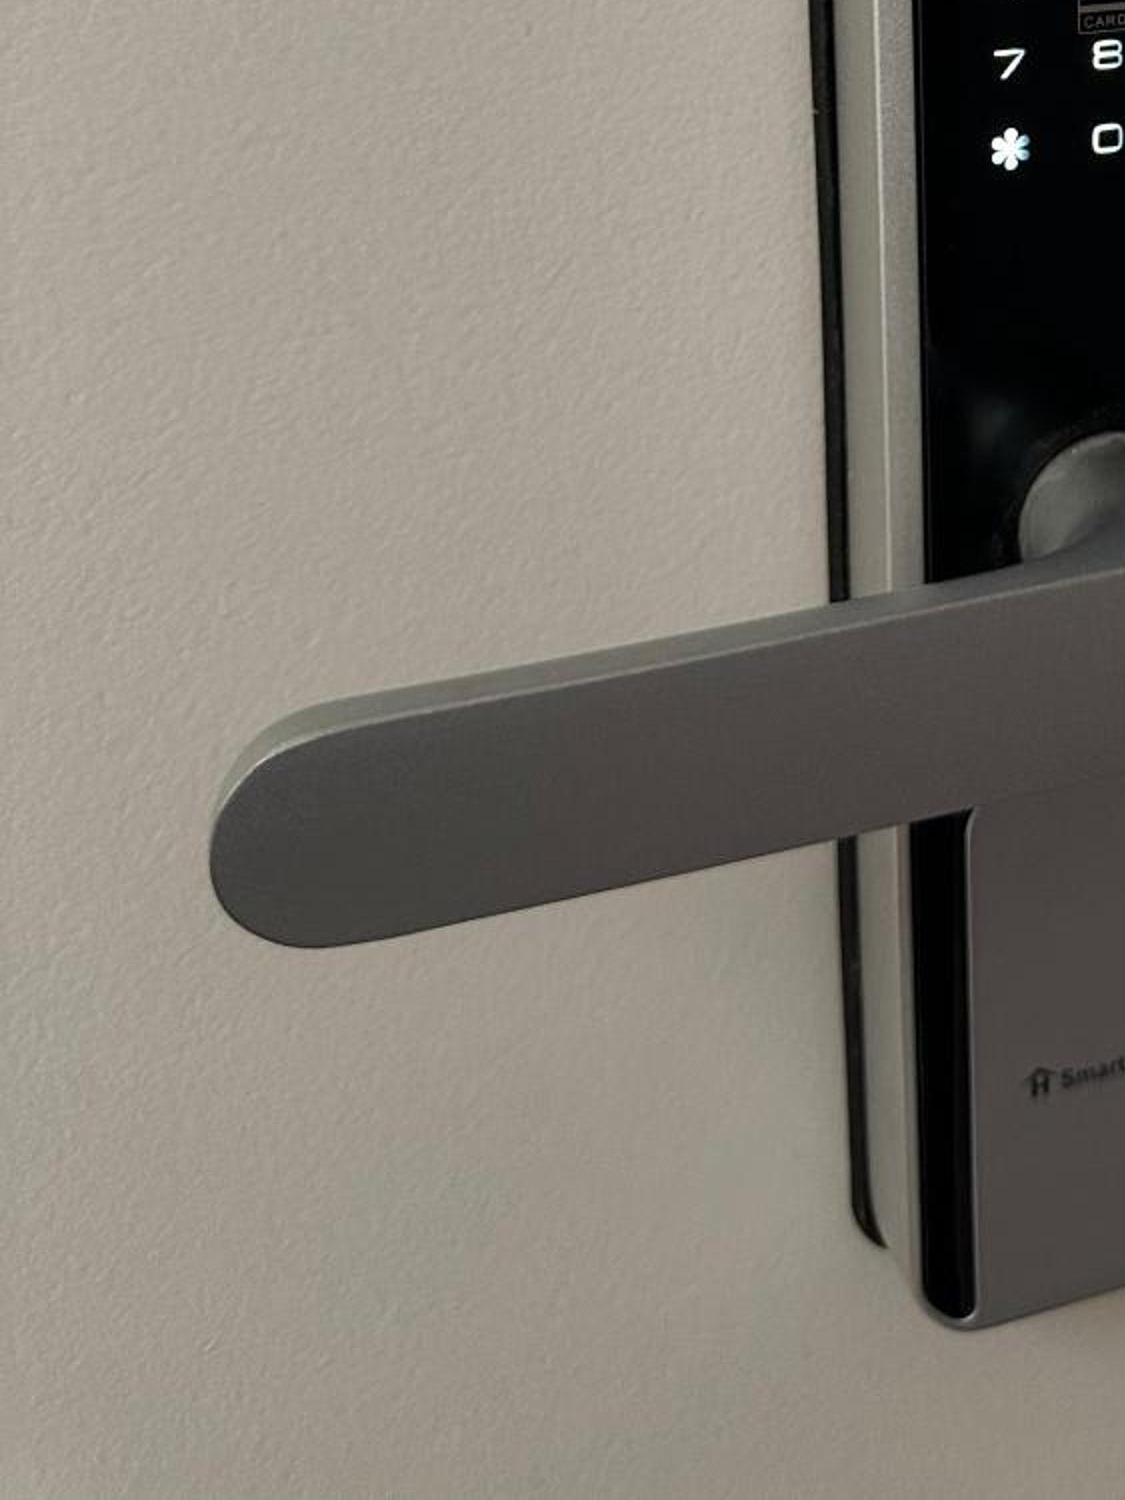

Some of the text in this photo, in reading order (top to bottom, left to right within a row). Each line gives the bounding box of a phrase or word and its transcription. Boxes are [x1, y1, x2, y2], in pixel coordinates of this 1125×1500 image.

[993, 47, 1026, 80] 7
[1092, 38, 1123, 71] 8
[1091, 122, 1124, 155] 0
[1061, 1056, 1125, 1088] Smart
